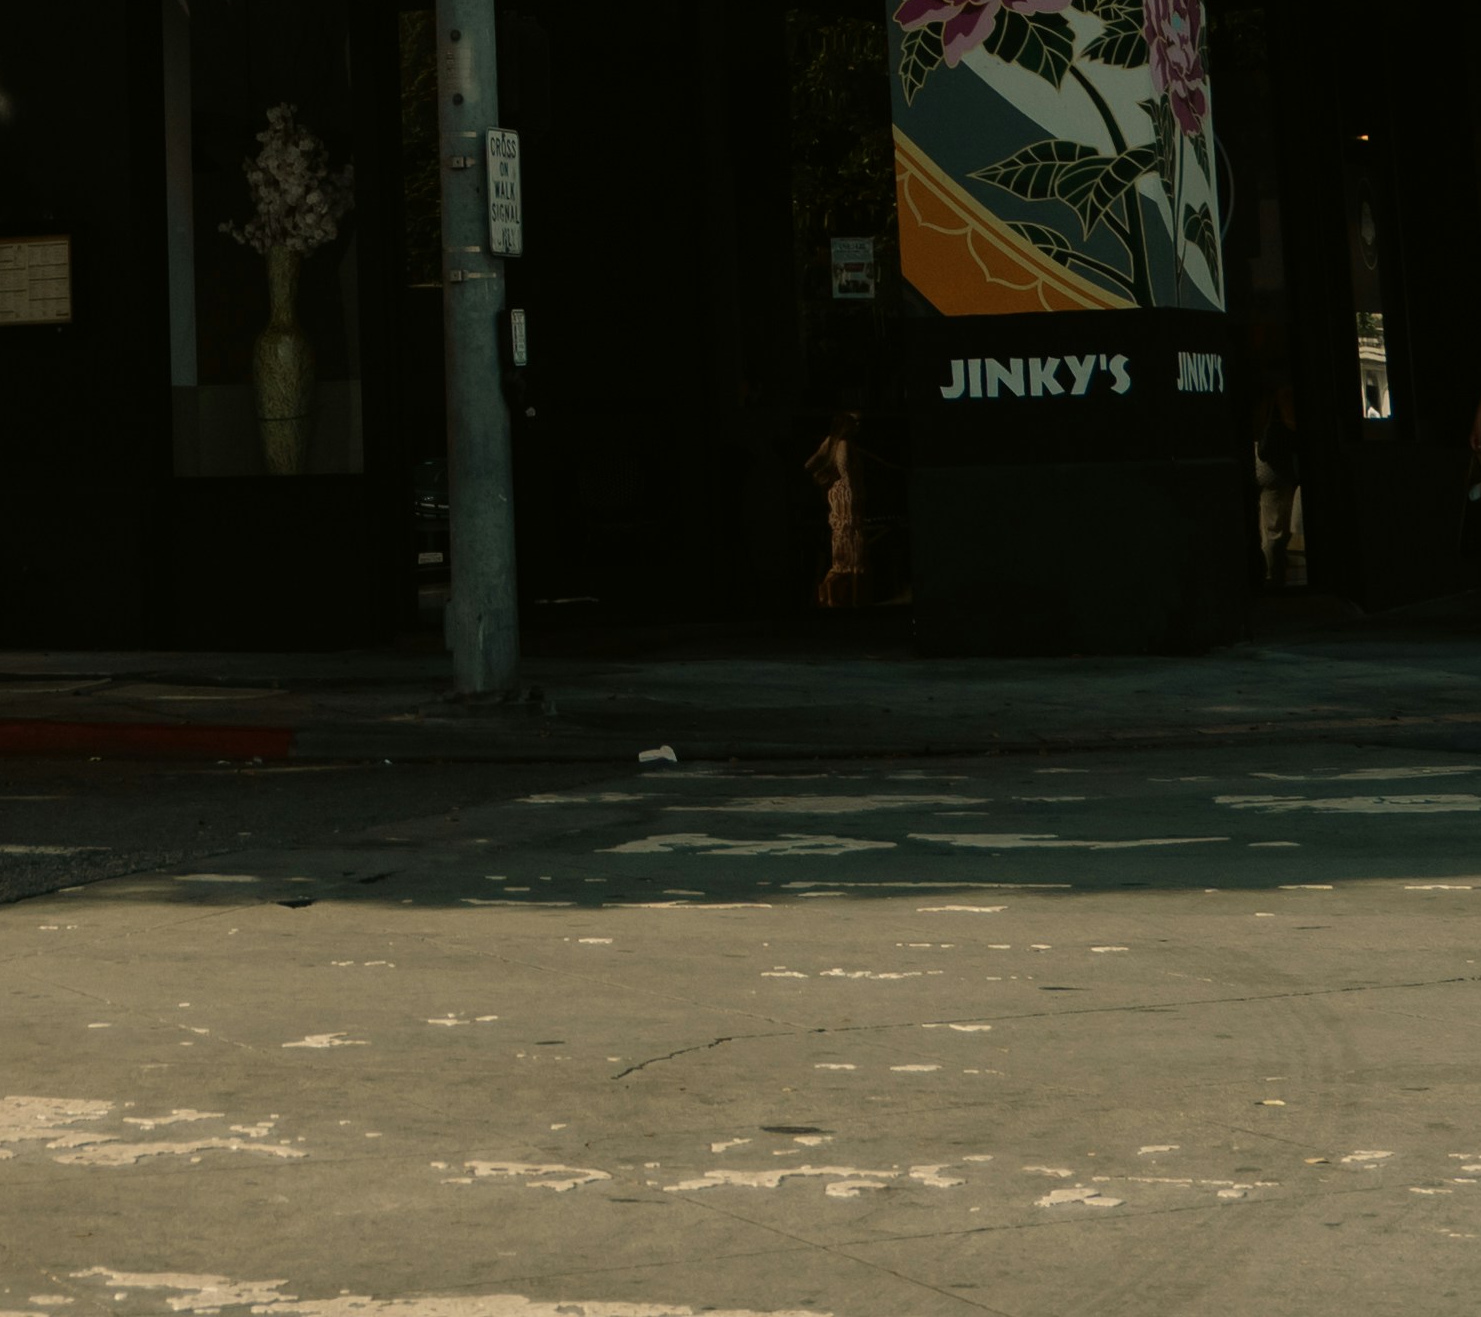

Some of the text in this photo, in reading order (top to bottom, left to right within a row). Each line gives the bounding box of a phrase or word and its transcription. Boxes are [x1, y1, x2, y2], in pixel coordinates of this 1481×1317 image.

[490, 137, 517, 160] CROSS
[499, 162, 509, 177] ON
[494, 180, 516, 202] WALK
[492, 204, 521, 225] SIGNAL
[939, 353, 1132, 400] JINKY'S
[1176, 351, 1224, 394] JINKY'S
